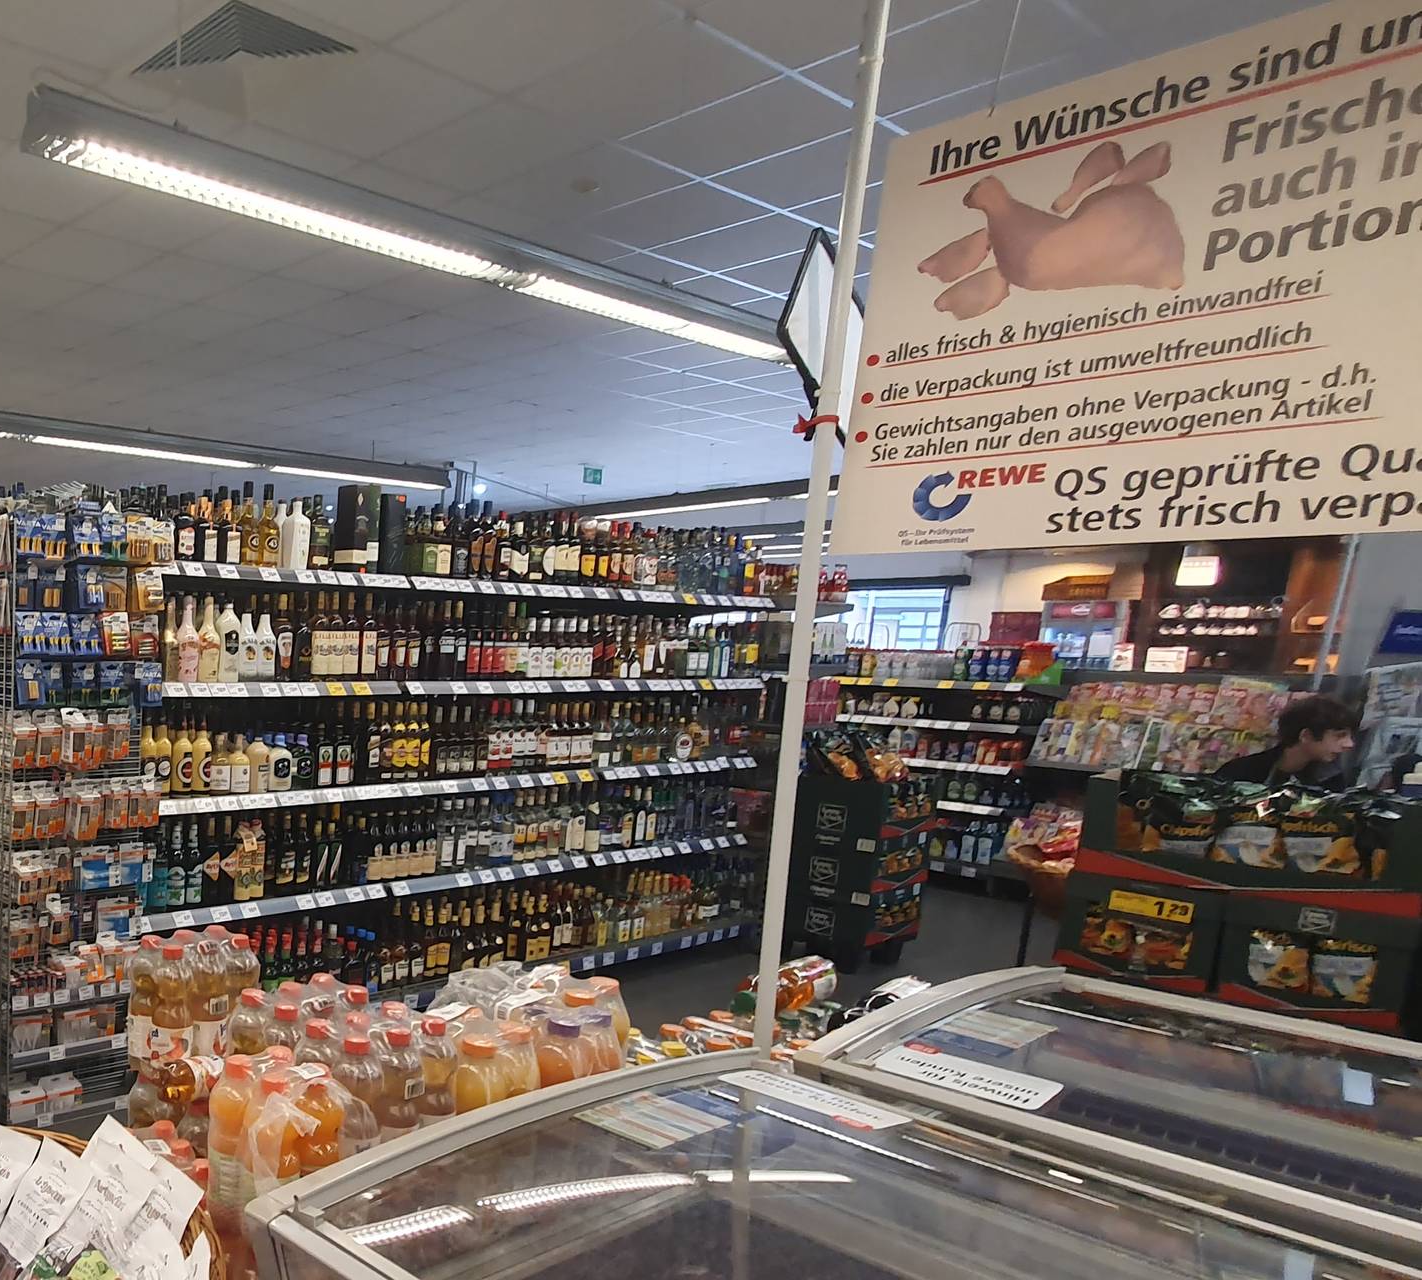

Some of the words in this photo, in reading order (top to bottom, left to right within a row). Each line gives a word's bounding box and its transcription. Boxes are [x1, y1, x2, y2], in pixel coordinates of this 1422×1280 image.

[929, 132, 1002, 176] Ihre
[1014, 75, 1211, 152] Wünsche
[1227, 22, 1343, 93] sind
[1212, 146, 1357, 217] auch
[885, 341, 930, 364] alles
[936, 328, 992, 356] frisch
[999, 325, 1016, 345] &
[1023, 302, 1147, 344] hygienisch
[1156, 270, 1325, 319] einwandfrei
[880, 383, 910, 403] die
[915, 365, 1038, 397] Verpackung
[1045, 358, 1073, 380] ist
[1080, 321, 1313, 374] umweltfreundlich
[871, 443, 900, 463] Sie
[903, 436, 969, 460] zahlen
[975, 433, 1012, 452] nur
[1018, 426, 1061, 448] den
[1066, 405, 1263, 443] ausgewogenen
[1270, 388, 1375, 421] Artikel
[874, 403, 1058, 442] Gewichtsangaben
[1065, 397, 1126, 419] ohne
[1134, 377, 1292, 411] Verpackung
[1321, 362, 1378, 389] d.h.
[957, 462, 1048, 490] REWE
[1054, 465, 1109, 502] QS
[1121, 449, 1322, 502] geprüfte
[1340, 443, 1422, 482] Qu
[1045, 503, 1143, 534] stets
[1158, 490, 1281, 528] frisch
[1301, 490, 1422, 528] verp
[898, 1056, 967, 1079] Kunden
[972, 1076, 1040, 1097] unsere
